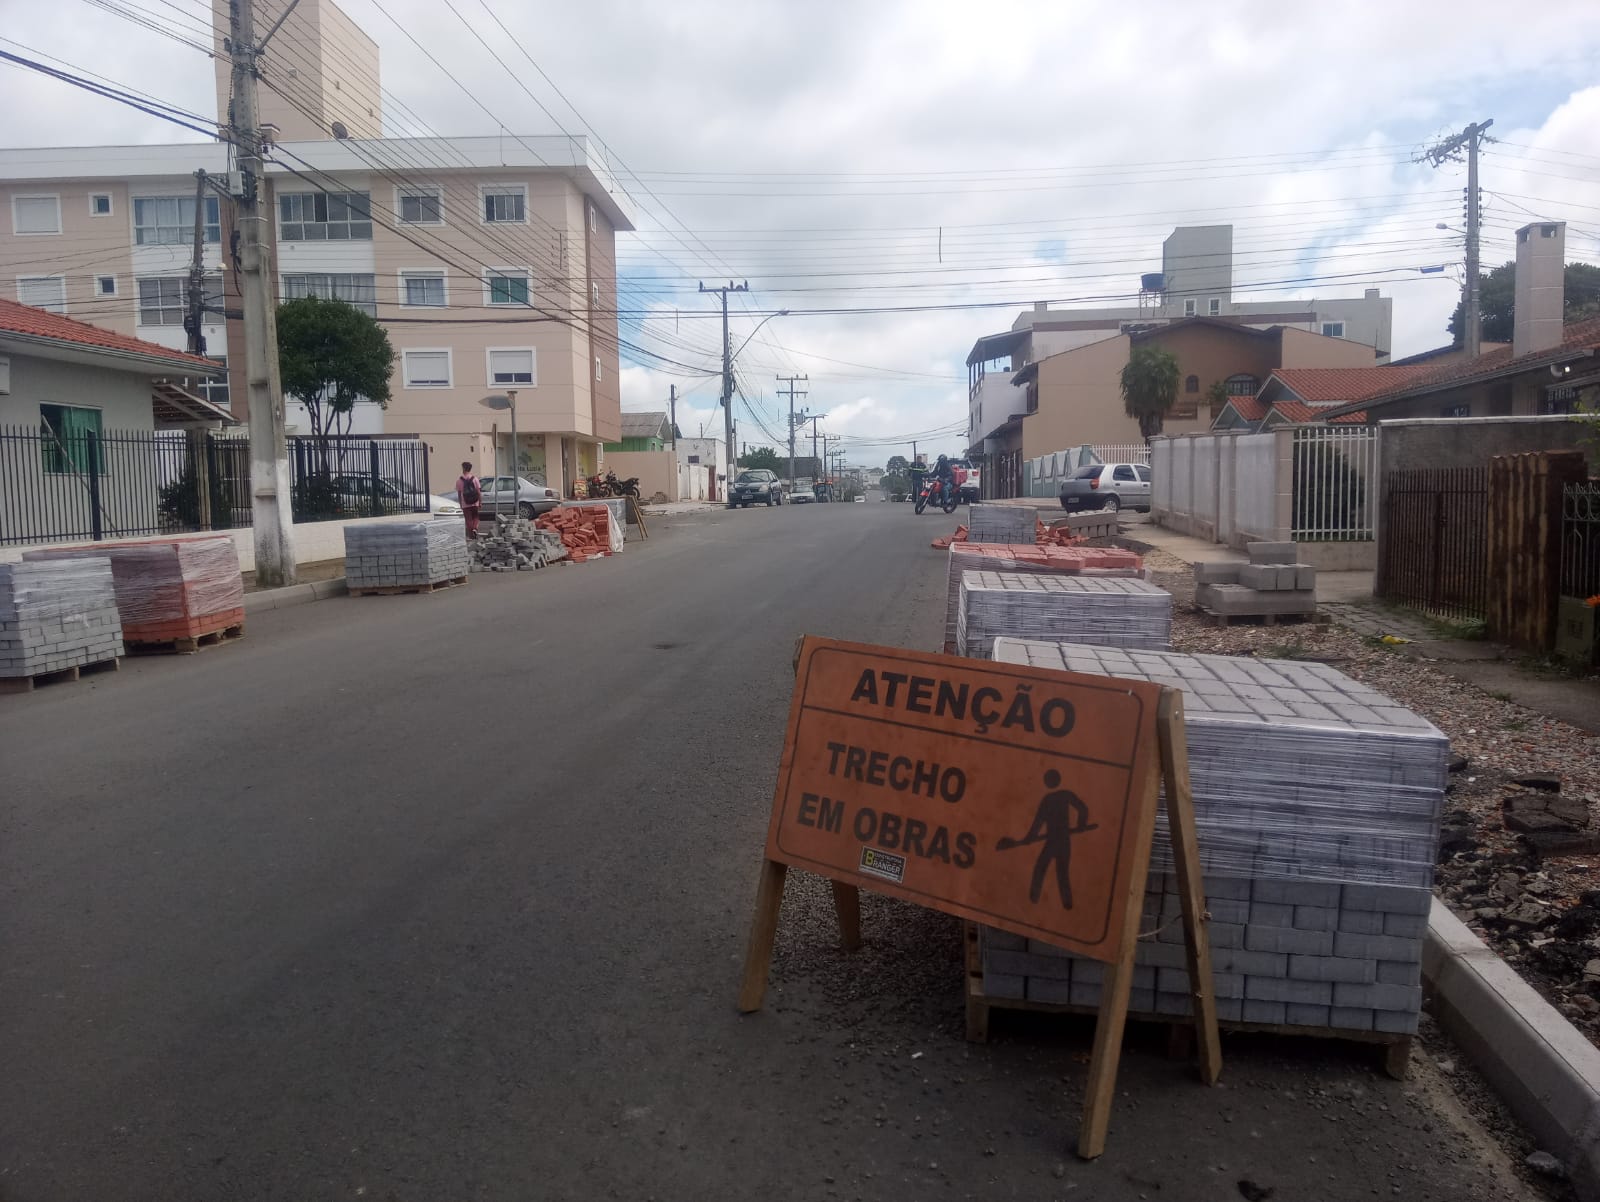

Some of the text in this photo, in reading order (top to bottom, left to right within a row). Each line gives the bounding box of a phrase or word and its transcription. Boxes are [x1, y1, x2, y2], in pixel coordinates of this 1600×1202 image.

[851, 668, 1076, 738] ATENÇÃO
[827, 741, 967, 804] TRECHO
[797, 792, 977, 870] EM OBRAS
